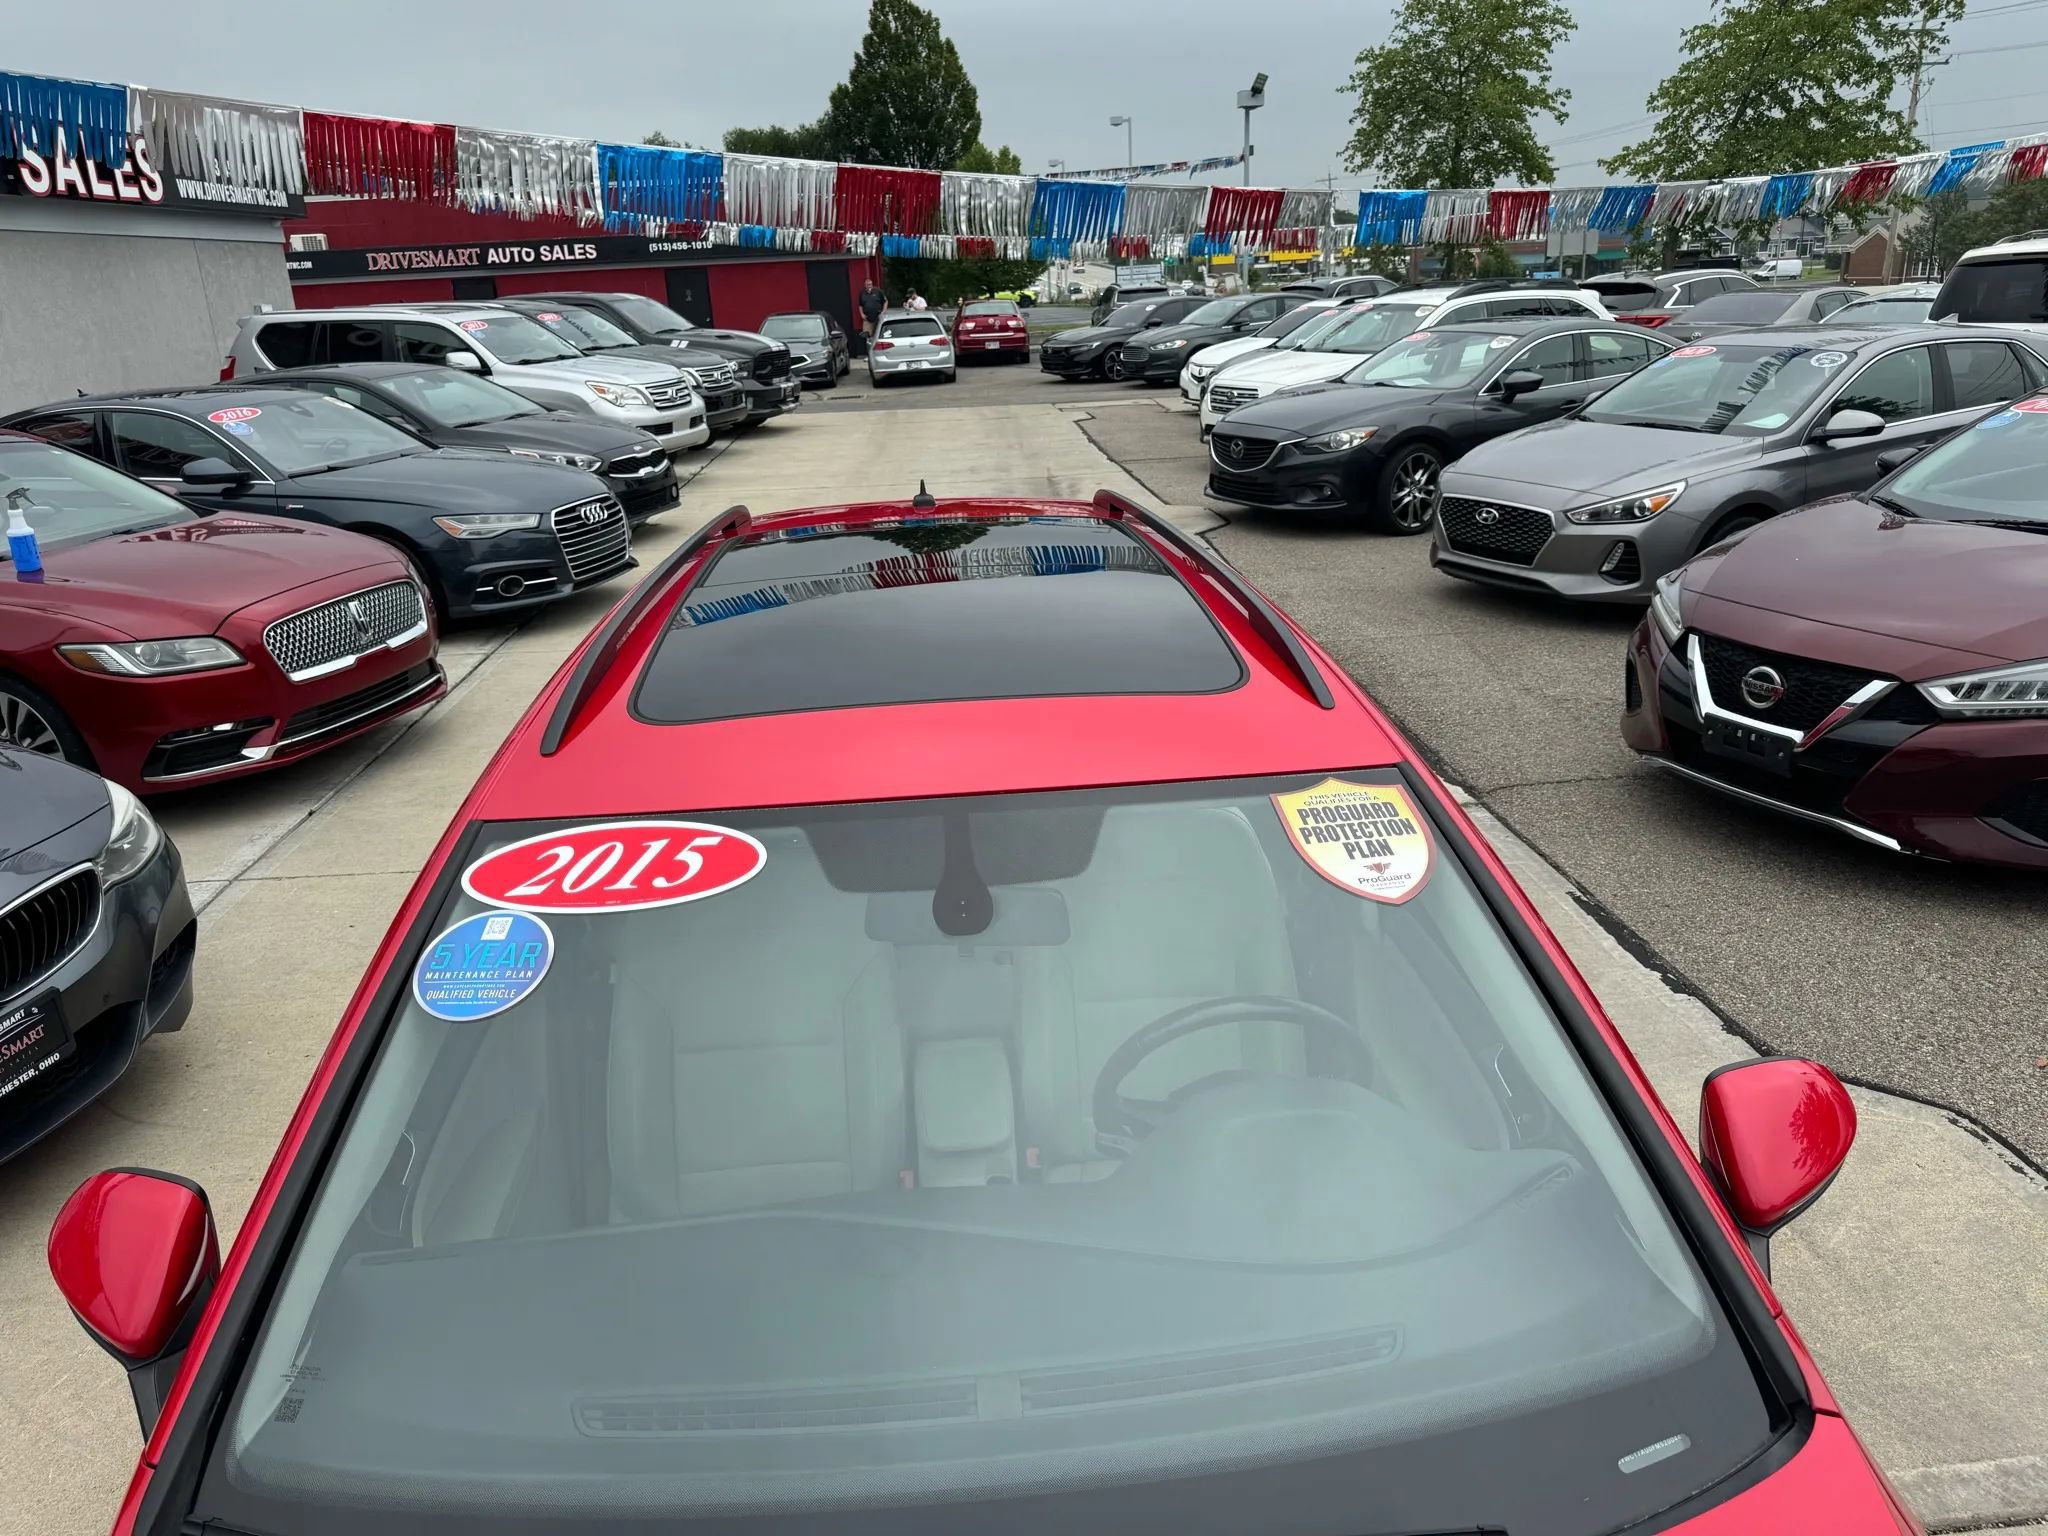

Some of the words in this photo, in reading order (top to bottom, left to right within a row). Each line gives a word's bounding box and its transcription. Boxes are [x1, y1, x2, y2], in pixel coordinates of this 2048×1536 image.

[17, 121, 165, 204] SALES
[176, 178, 289, 208] WWW.DRIVESMARTWC.COM
[366, 248, 481, 271] DRIVESMART
[487, 247, 535, 265] AUTO
[540, 243, 598, 262] SALES
[649, 241, 713, 253] (513)456-1010
[219, 409, 253, 422] 2016
[1296, 801, 1400, 825] PROGUARD
[1298, 817, 1418, 845] PROTECTION
[1341, 838, 1395, 860] PLAN
[503, 836, 724, 897] 2015
[1358, 872, 1412, 885] ProGuard
[430, 943, 456, 970] 5
[463, 942, 543, 970] YEAR
[425, 970, 500, 981] MAINTENANCE
[505, 970, 534, 979] PLAN
[426, 989, 475, 1001] QUALIFIED
[478, 988, 517, 999] VEHICLE
[38, 1052, 60, 1071] OHIO
